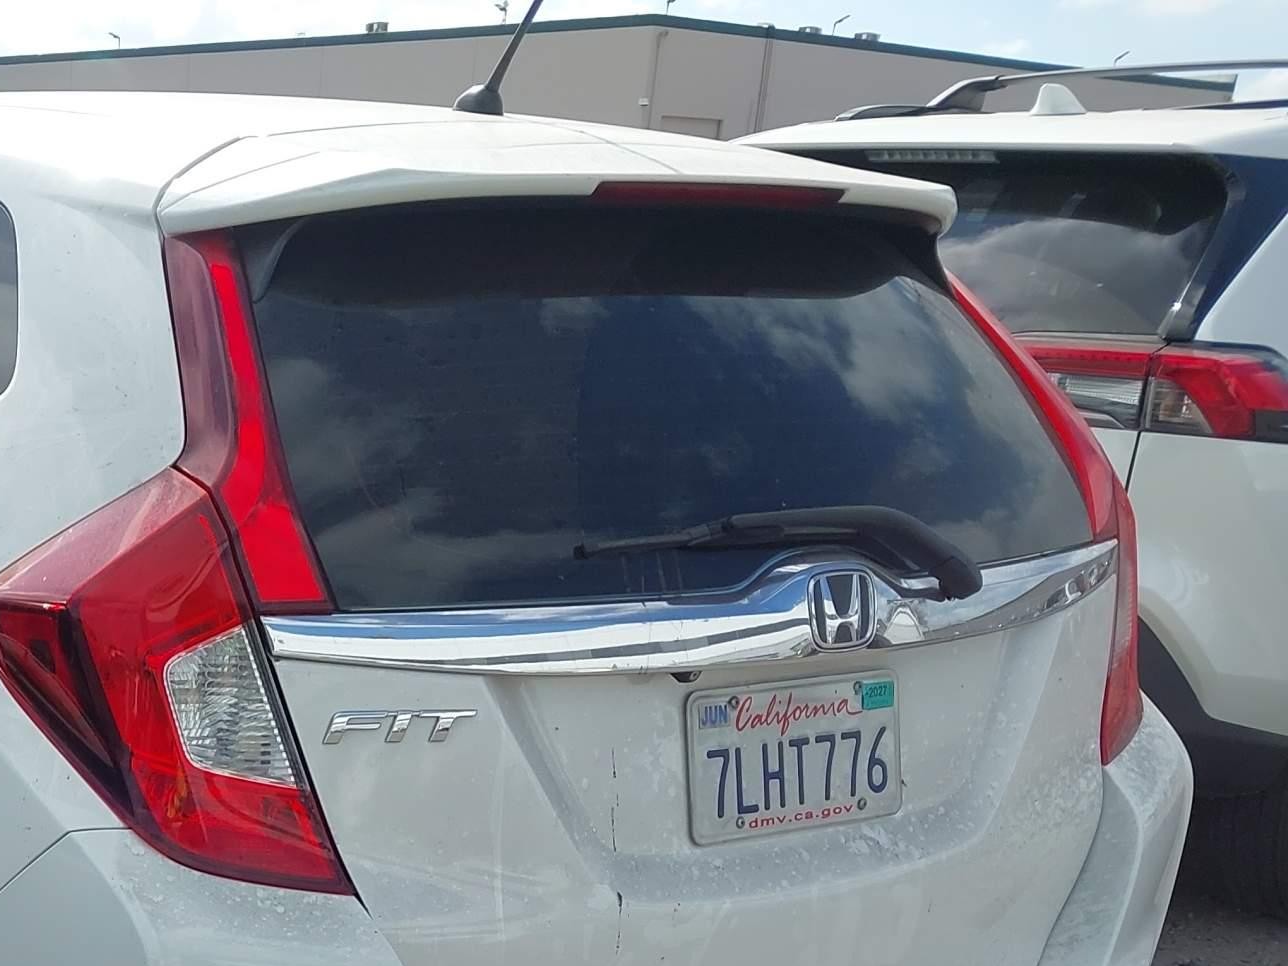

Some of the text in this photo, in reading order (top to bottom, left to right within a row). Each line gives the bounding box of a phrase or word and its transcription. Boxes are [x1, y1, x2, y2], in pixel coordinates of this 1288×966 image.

[322, 709, 478, 745] FIT
[700, 704, 729, 726] JUN
[735, 692, 863, 736] California
[706, 725, 889, 819] 7LHT776
[748, 803, 854, 829] dmv.ca.gov
